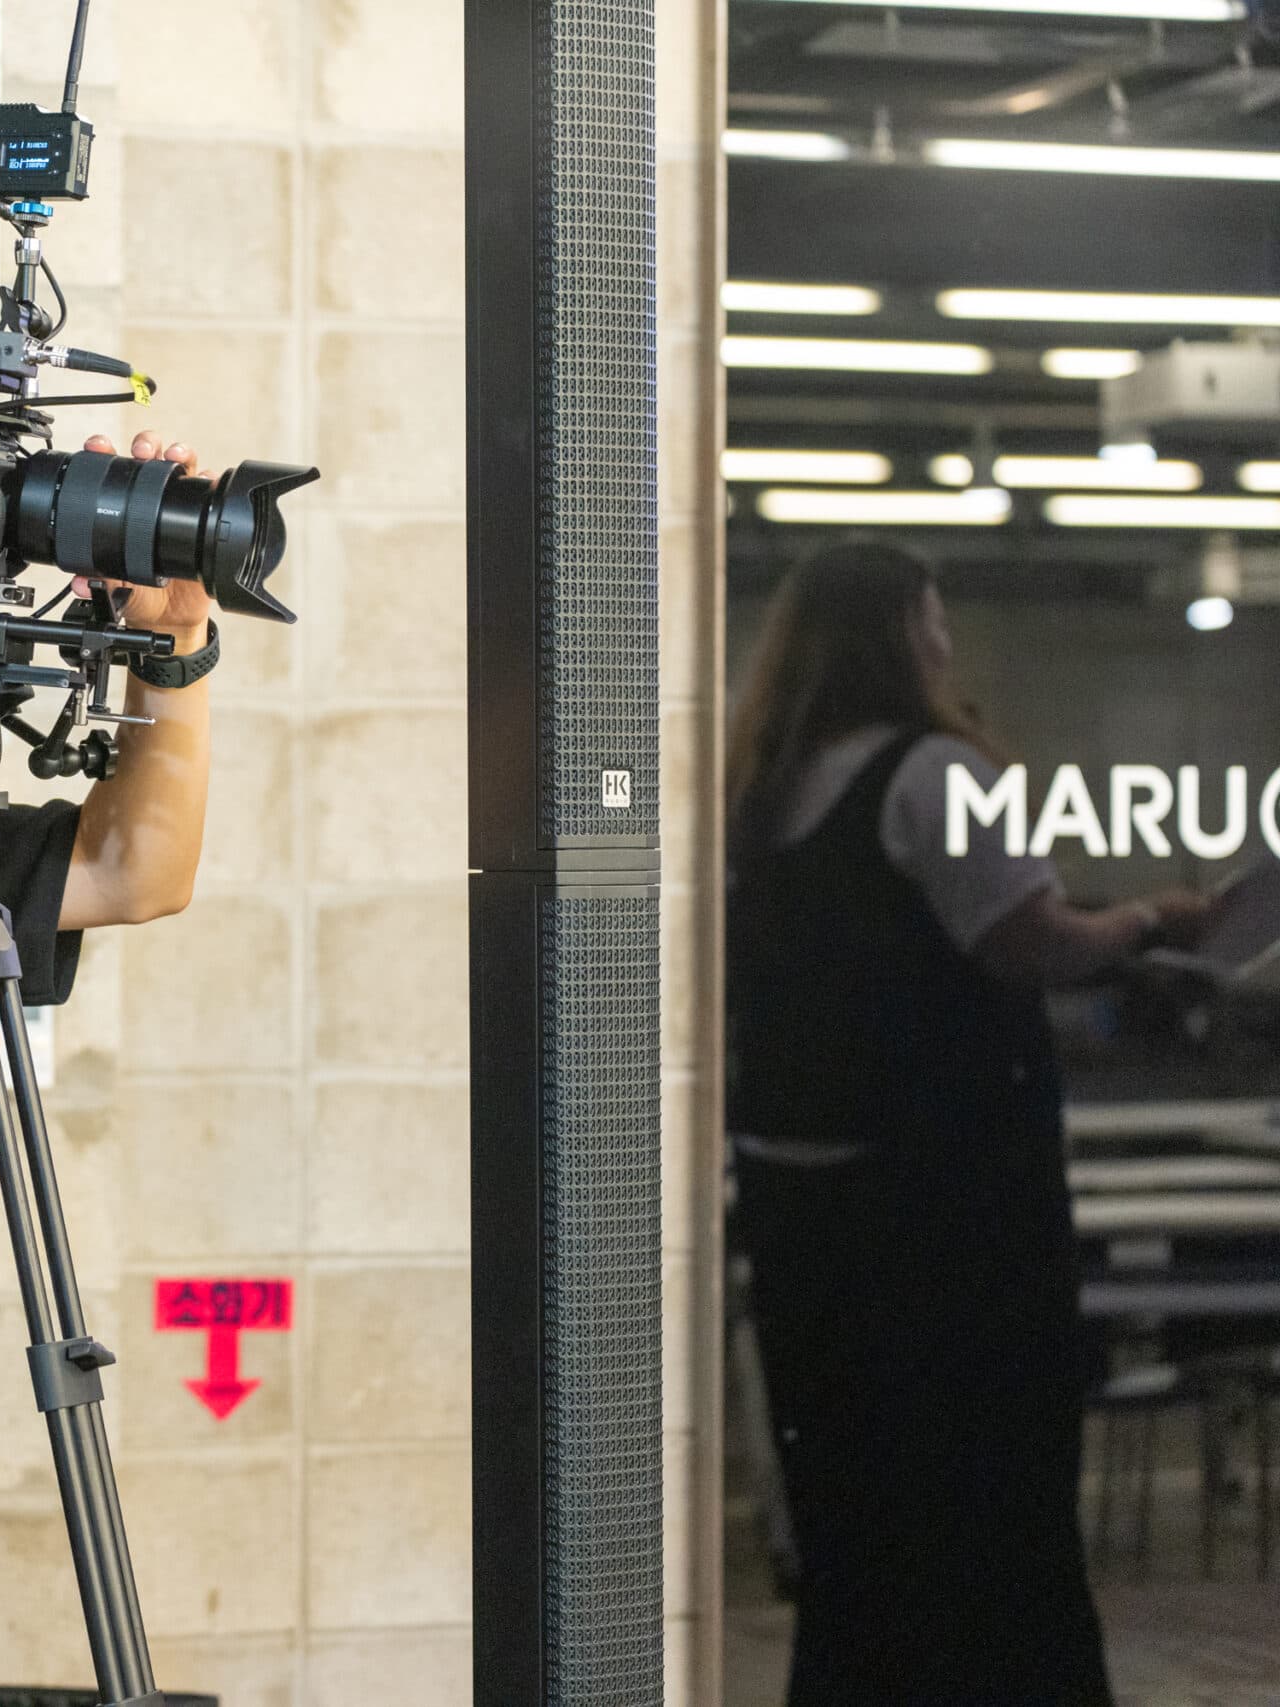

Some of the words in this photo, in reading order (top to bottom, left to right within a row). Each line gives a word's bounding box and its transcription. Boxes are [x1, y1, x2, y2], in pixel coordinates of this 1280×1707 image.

[96, 507, 121, 517] SONY
[605, 774, 627, 796] HK
[945, 762, 1280, 860] MARU
